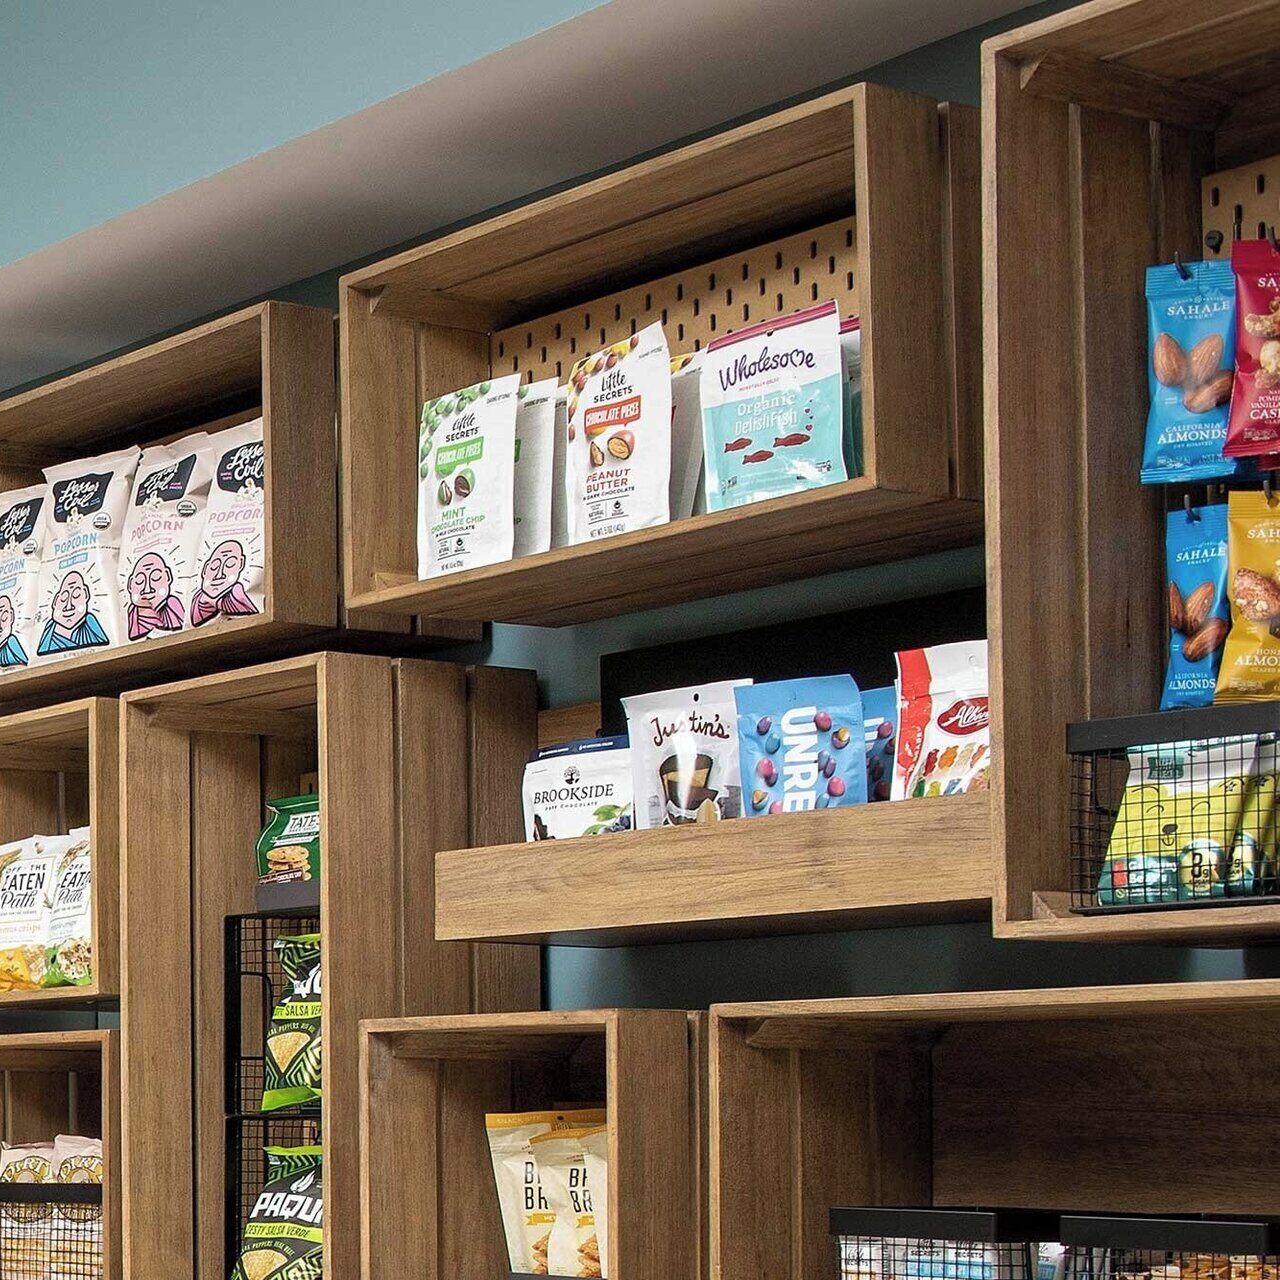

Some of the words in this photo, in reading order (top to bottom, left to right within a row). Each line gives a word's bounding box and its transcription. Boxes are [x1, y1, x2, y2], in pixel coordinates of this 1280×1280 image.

[1166, 300, 1231, 317] SAHALE
[718, 345, 817, 392] Wholesome
[601, 368, 628, 392] Little
[593, 388, 633, 404] SECRETS
[737, 392, 797, 417] Organic
[451, 412, 476, 433] Little
[1165, 421, 1221, 434] CALIFORNIA
[445, 426, 479, 443] SECRETS
[1157, 428, 1228, 445] ALMONDS
[585, 467, 632, 483] PEANUT
[58, 480, 99, 503] Lesser
[586, 476, 629, 494] BUTTER
[603, 486, 635, 497] CHOCOLATE
[64, 492, 92, 511] Evil
[441, 507, 466, 519] MINT
[465, 513, 486, 525] CHIP
[130, 519, 185, 543] POPCORN
[54, 532, 98, 555] POPCORN
[1175, 544, 1227, 563] SAHALE
[1167, 678, 1216, 691] ALMONDS
[533, 783, 615, 805] BROOKSIDE
[560, 801, 598, 810] CHOCOLATE
[30, 863, 47, 872] THE
[0, 890, 38, 910] Path
[284, 1003, 309, 1017] SALSA
[266, 1224, 285, 1237] SALSA
[286, 1225, 311, 1239] VERDE
